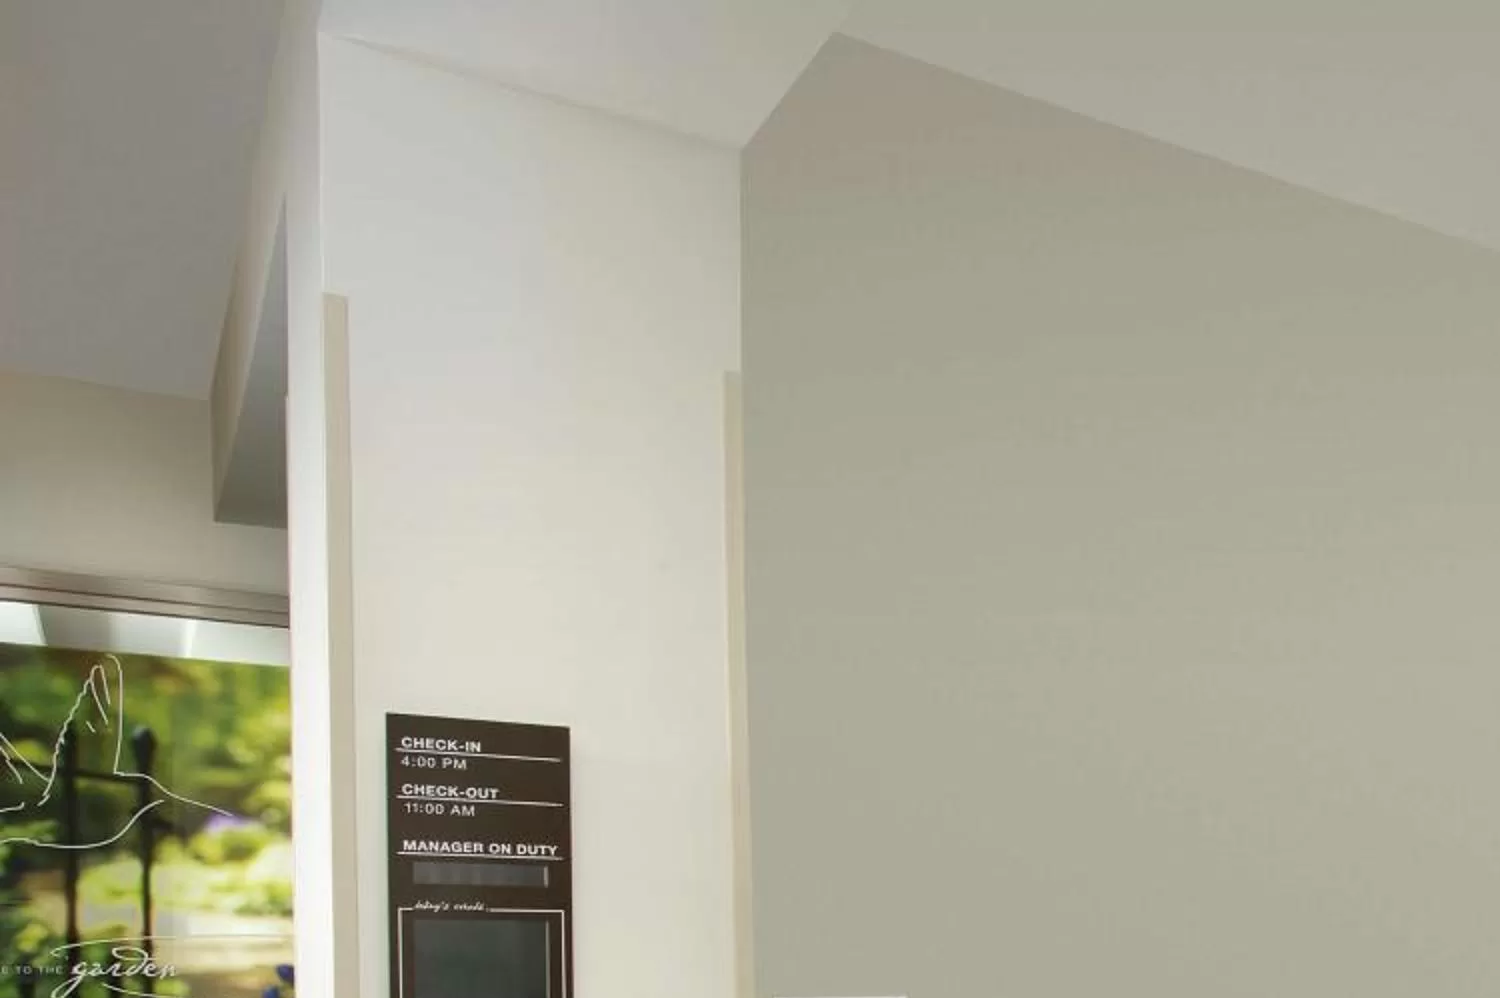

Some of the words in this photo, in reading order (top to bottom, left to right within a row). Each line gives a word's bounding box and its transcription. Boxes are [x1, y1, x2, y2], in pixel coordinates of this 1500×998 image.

[401, 736, 482, 753] CHECK-IN
[401, 755, 436, 769] 4:00
[441, 758, 468, 771] PM
[401, 783, 500, 800] CHECK-OUT
[404, 802, 445, 816] 11:00
[450, 804, 476, 817] AM
[402, 839, 484, 854] MANAGER
[488, 842, 512, 855] ON
[516, 844, 558, 857] DUTY
[16, 965, 33, 975] TO
[39, 965, 64, 976] THE
